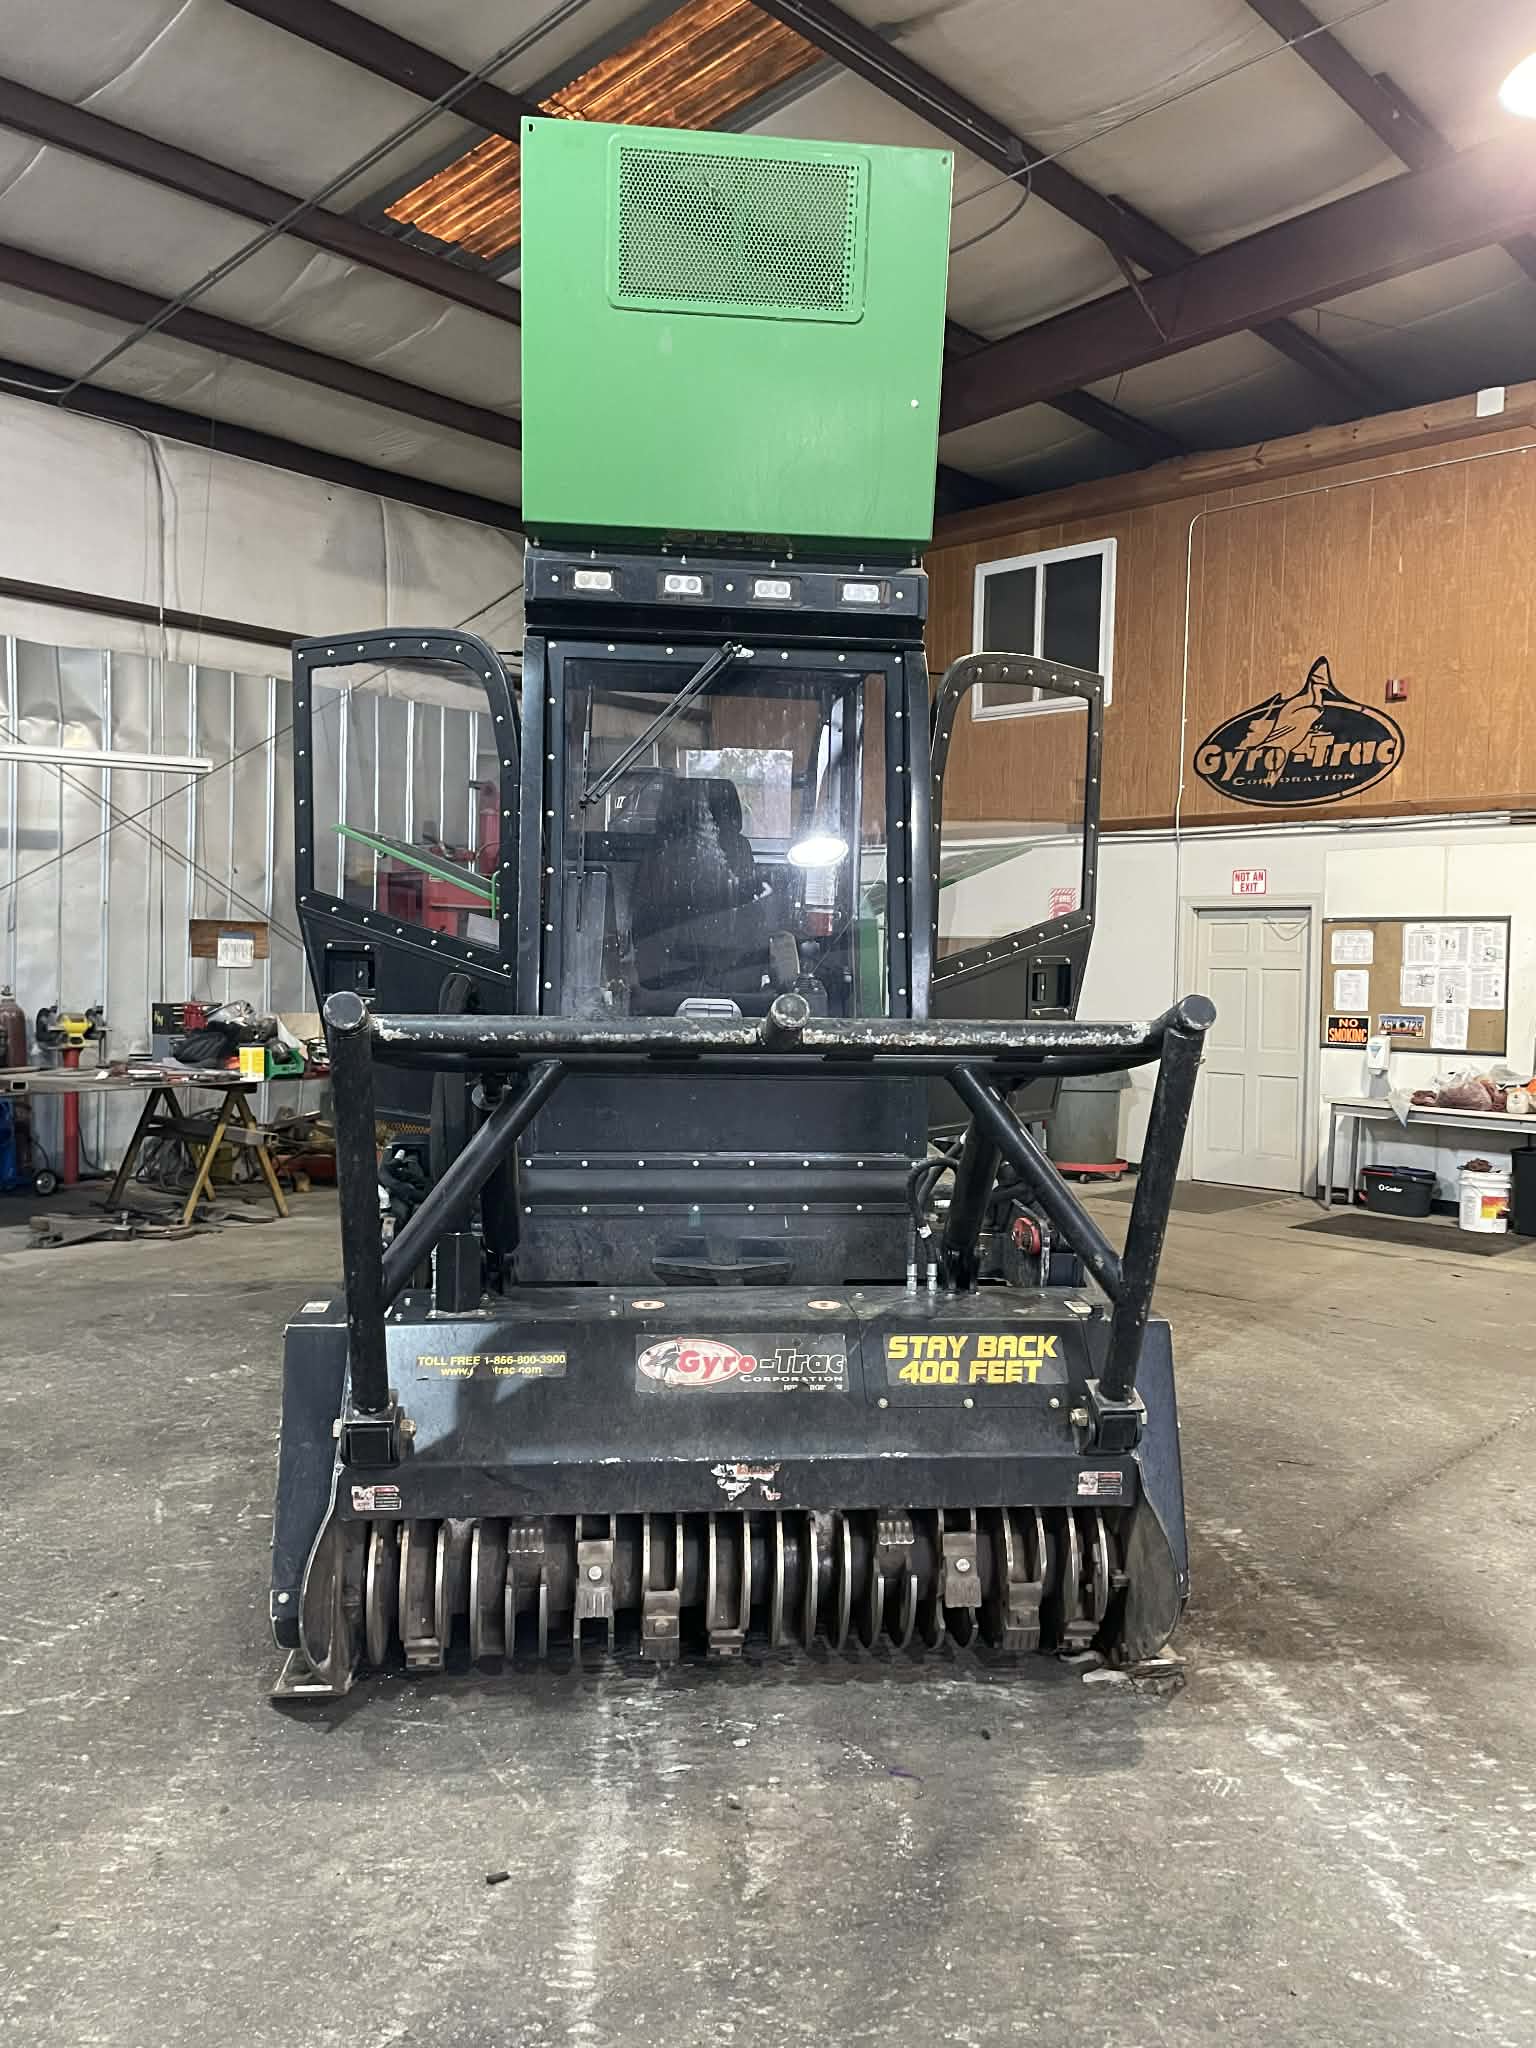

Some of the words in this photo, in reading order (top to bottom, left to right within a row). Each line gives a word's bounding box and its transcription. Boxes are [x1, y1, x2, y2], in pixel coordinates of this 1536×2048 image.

[1196, 735, 1397, 782] Gyro-Trac
[1234, 871, 1250, 882] NOT
[1253, 871, 1264, 881] AN
[1240, 882, 1258, 892] EXIT
[1338, 1018, 1359, 1028] NO
[1328, 1027, 1367, 1042] SMOKING
[887, 1335, 969, 1359] STAY
[977, 1335, 1058, 1358] BACK
[417, 1356, 448, 1366] TOLL
[451, 1355, 481, 1366] FREE
[484, 1354, 566, 1365] 1-866-800-3900
[677, 1348, 845, 1379] Gyro-Trac
[899, 1360, 961, 1384] 400
[968, 1360, 1043, 1383] FEET
